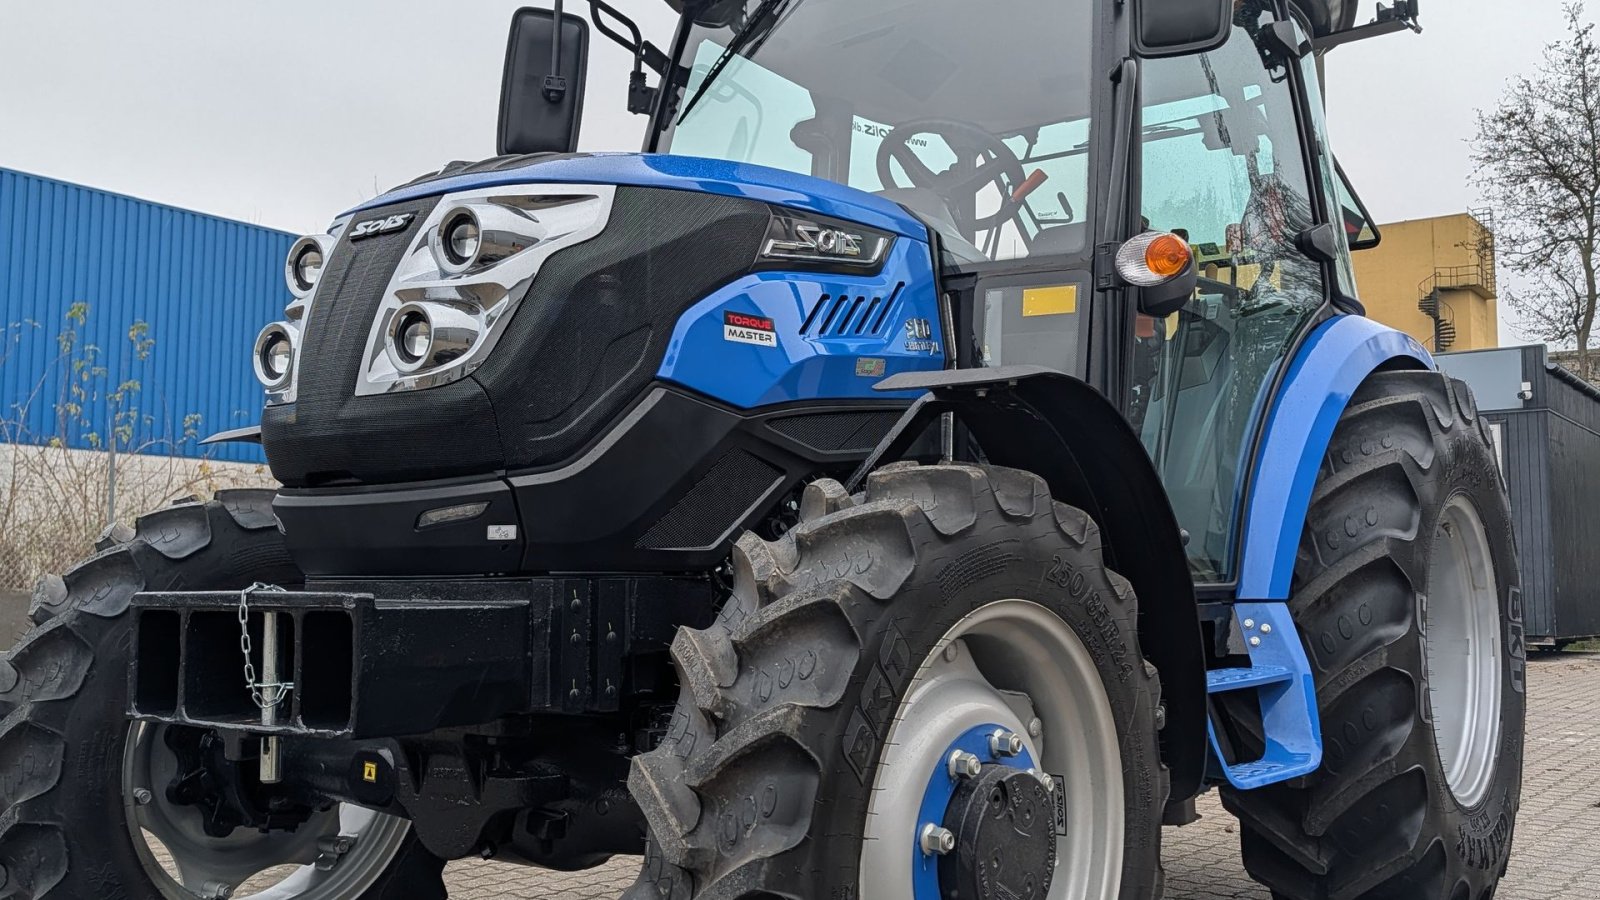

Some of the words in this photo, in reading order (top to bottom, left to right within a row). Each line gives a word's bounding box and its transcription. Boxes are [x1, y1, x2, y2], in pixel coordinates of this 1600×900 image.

[728, 314, 772, 330] TORQUE
[728, 328, 773, 342] MASTER
[1507, 585, 1526, 693] BKT
